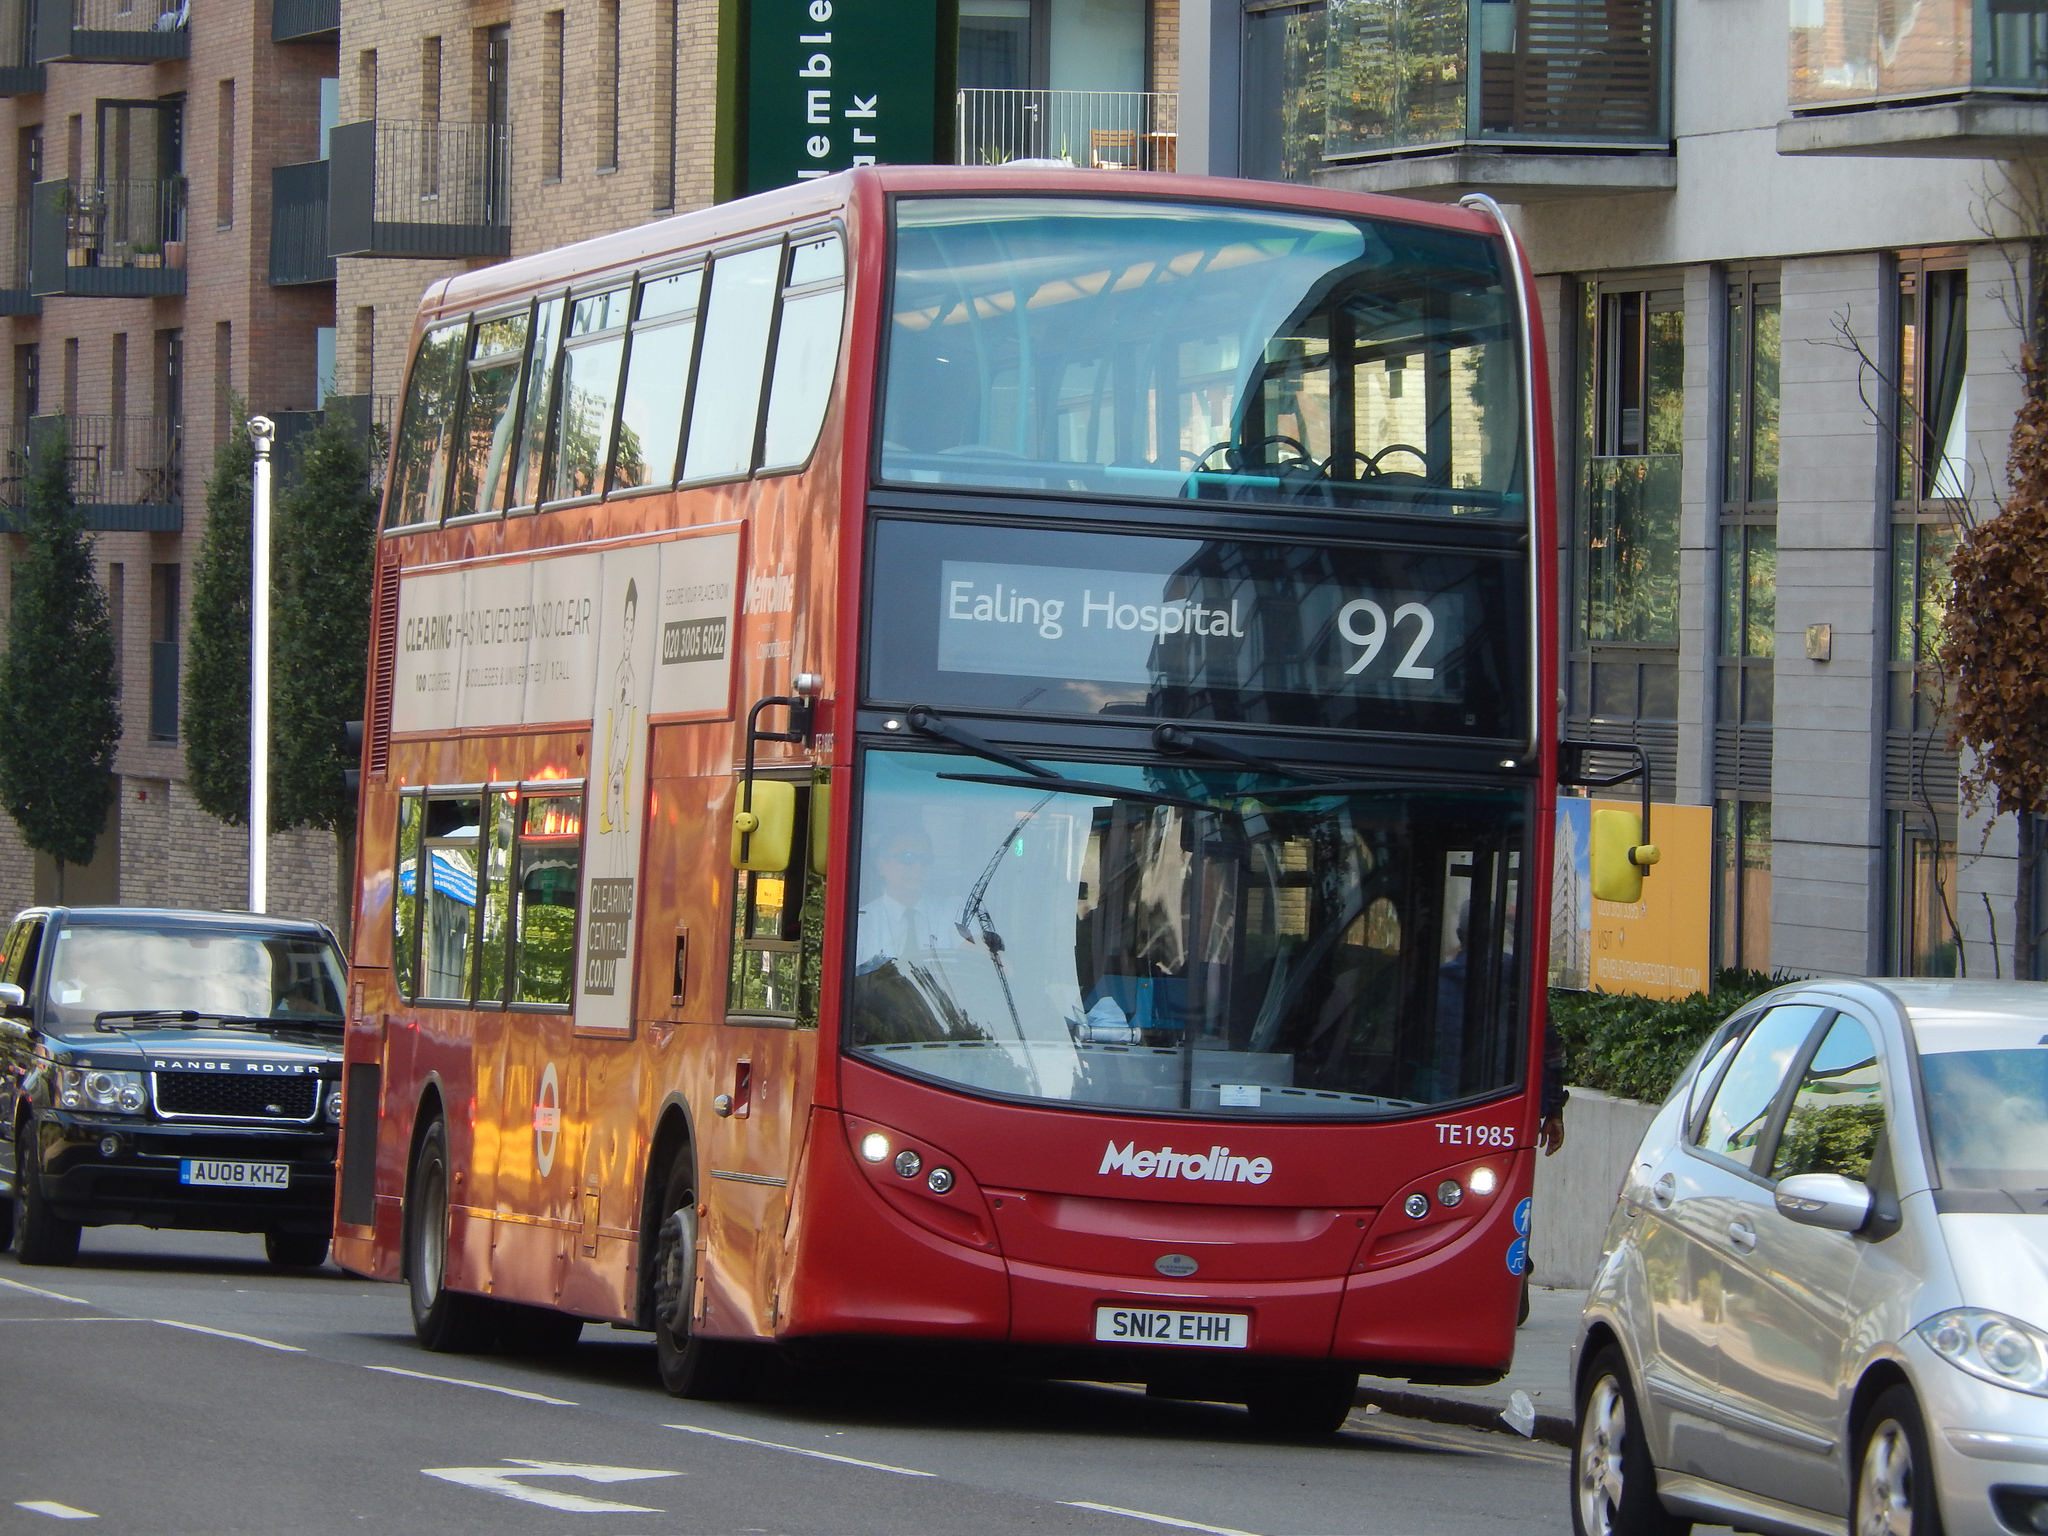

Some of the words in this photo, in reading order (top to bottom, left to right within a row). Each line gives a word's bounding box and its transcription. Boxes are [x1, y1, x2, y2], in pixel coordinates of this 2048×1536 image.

[743, 562, 794, 615] Metroline
[405, 614, 452, 652] CLEARING
[454, 610, 474, 648] HAS
[478, 607, 509, 645] NEVER
[513, 604, 538, 643] BEEN
[541, 602, 552, 638] SO
[555, 598, 591, 637] CLEAR
[949, 580, 1065, 640] Ealing
[1082, 588, 1244, 645] Hospital
[664, 629, 680, 659] 020
[681, 626, 701, 657] 3005
[702, 623, 725, 655] 6022
[1337, 597, 1436, 680] 92
[415, 673, 427, 692] 100
[590, 885, 633, 914] CLEARING
[588, 922, 627, 951] CENTRAL
[585, 959, 617, 988] .CO.UK
[154, 1060, 231, 1070] RANGE
[246, 1063, 320, 1074] ROVER
[1435, 1123, 1516, 1148] TE1985
[195, 1162, 245, 1183] AU08
[249, 1165, 288, 1184] KHZ
[1098, 1139, 1273, 1185] Metroline
[1112, 1311, 1171, 1339] SN12
[1178, 1315, 1231, 1342] EHH
